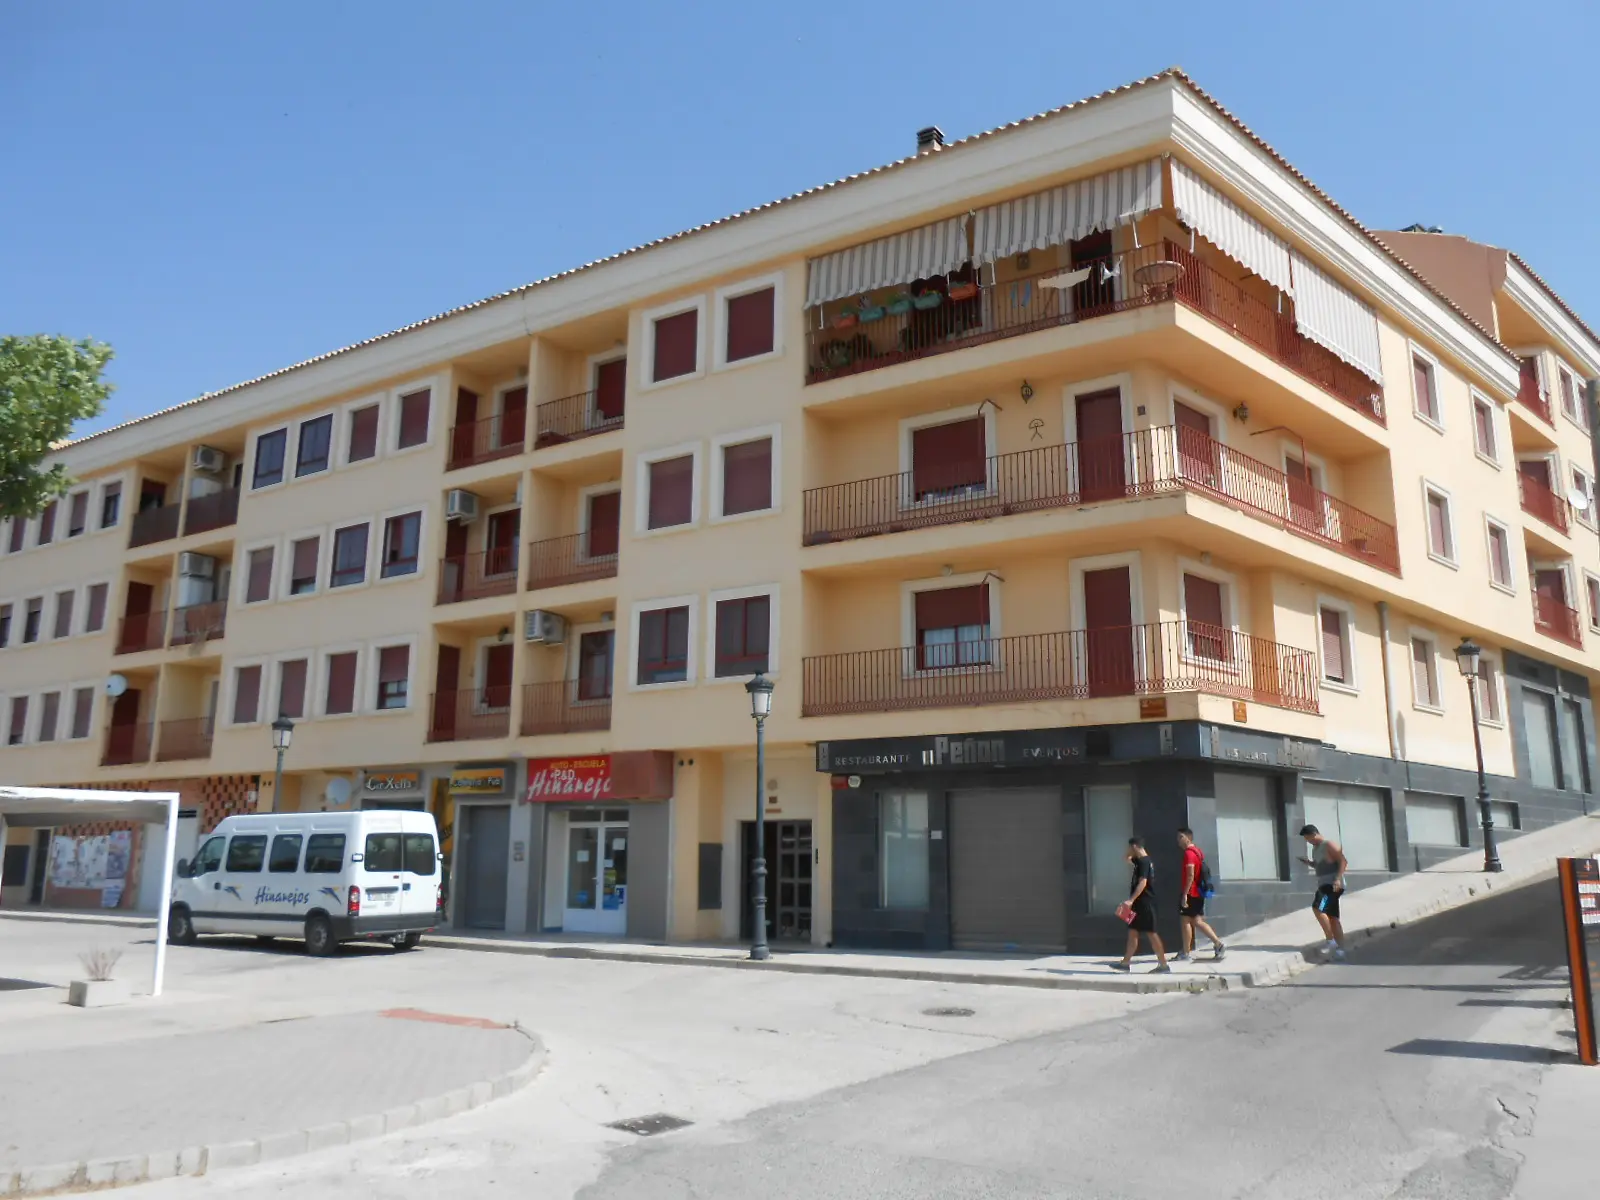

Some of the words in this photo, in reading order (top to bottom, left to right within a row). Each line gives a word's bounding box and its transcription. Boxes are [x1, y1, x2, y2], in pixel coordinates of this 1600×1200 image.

[835, 754, 911, 766] RESTAURANTE
[1023, 747, 1079, 760] EVENTOS
[255, 886, 310, 907] Hinarejos
